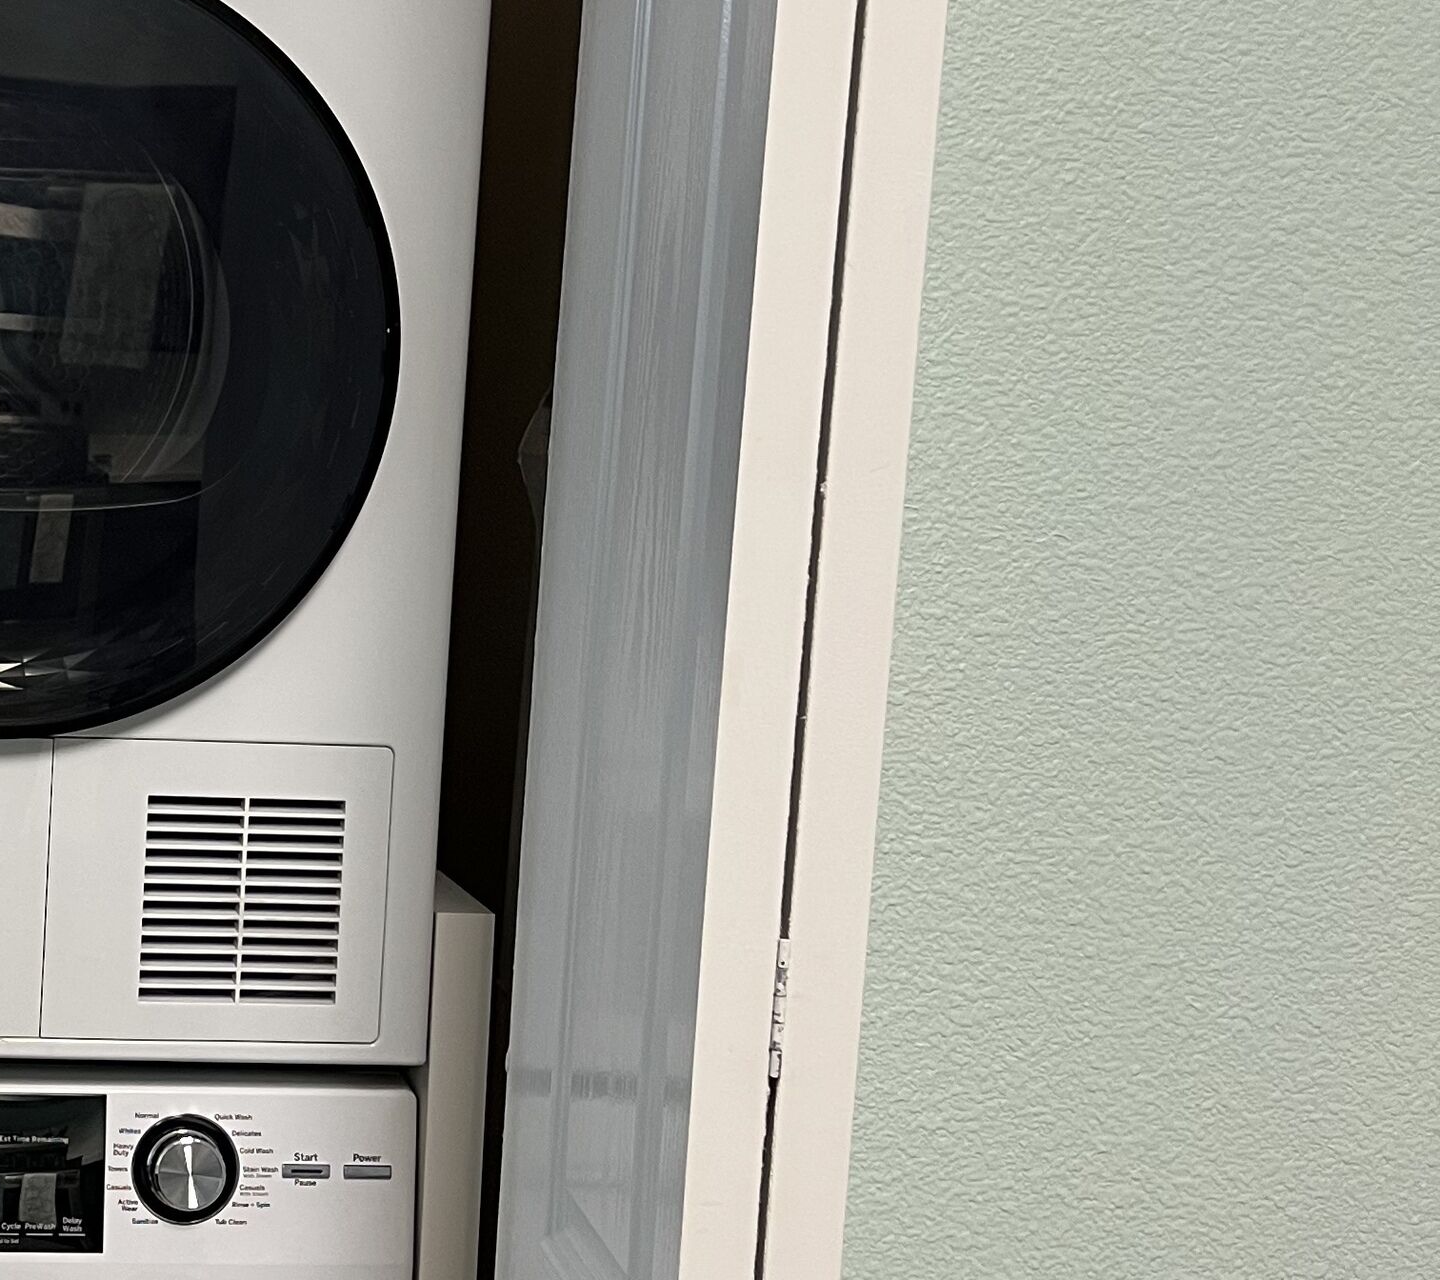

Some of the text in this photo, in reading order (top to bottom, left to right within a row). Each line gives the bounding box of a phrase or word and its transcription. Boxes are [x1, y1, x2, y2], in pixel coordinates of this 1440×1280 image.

[214, 1113, 233, 1121] Quick
[293, 1152, 381, 1163] Start Power
[294, 1179, 317, 1187] Pause
[1, 1222, 21, 1231] Cycle
[24, 1222, 56, 1230] PreWash
